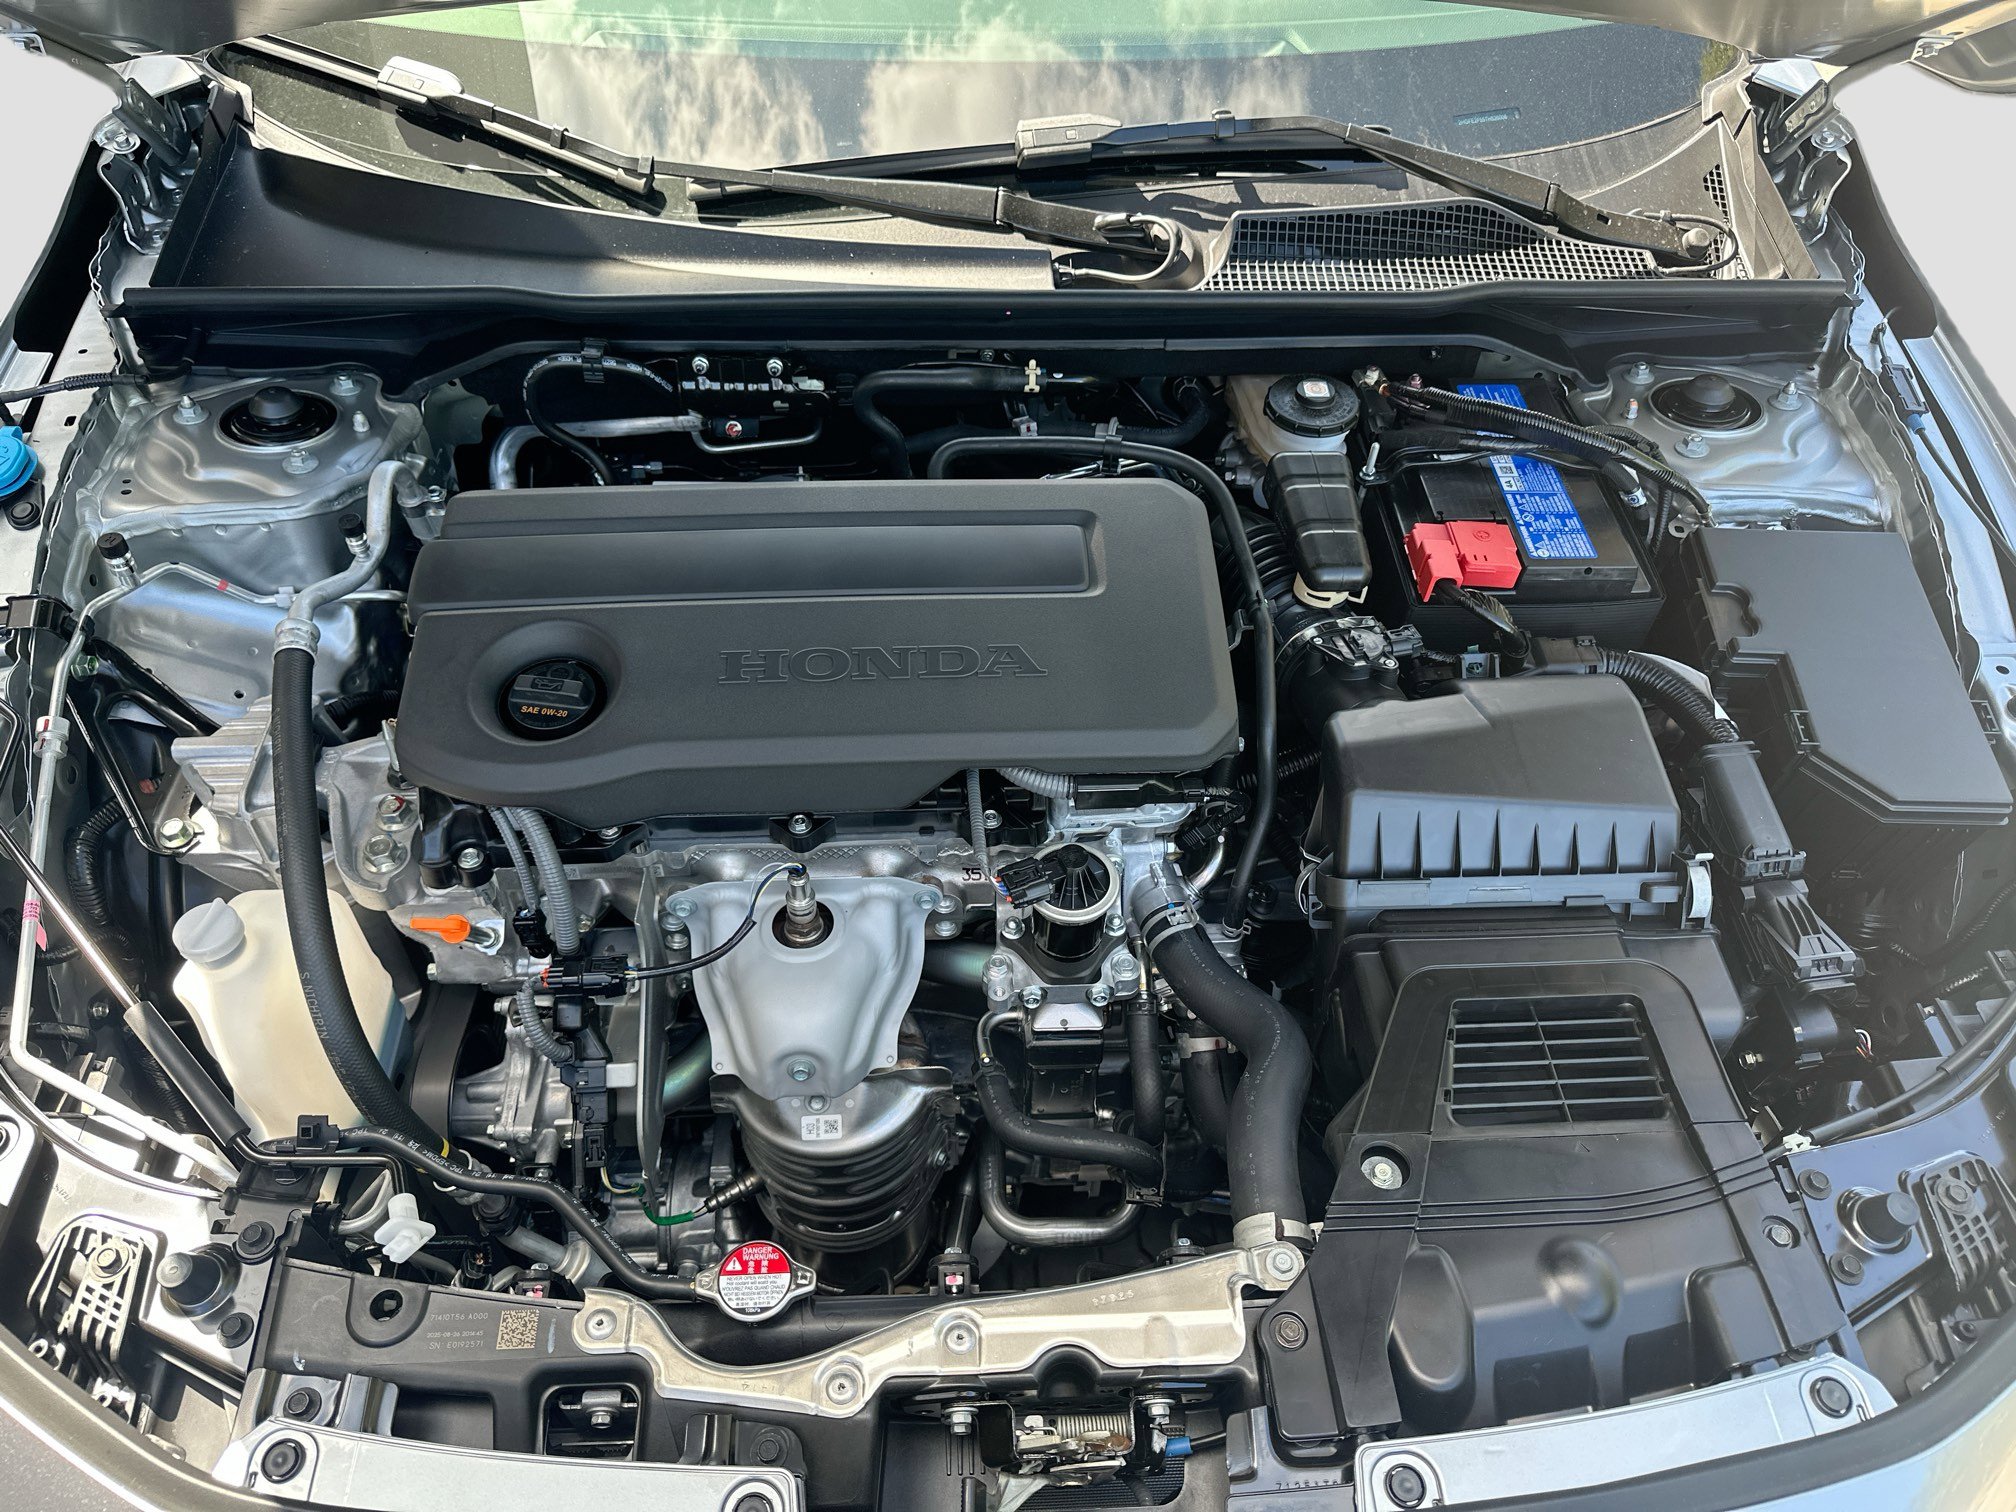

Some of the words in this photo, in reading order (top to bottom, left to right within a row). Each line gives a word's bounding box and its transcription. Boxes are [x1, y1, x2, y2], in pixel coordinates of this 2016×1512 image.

[718, 643, 1048, 684] HONDA
[520, 705, 540, 714] SAE
[541, 707, 568, 718] 0W-20
[742, 1246, 773, 1254] DANGER
[742, 1252, 779, 1260] WARNUNG
[430, 1313, 466, 1321] 71410T56
[468, 1312, 489, 1320] A000
[446, 1340, 484, 1349] E0192571
